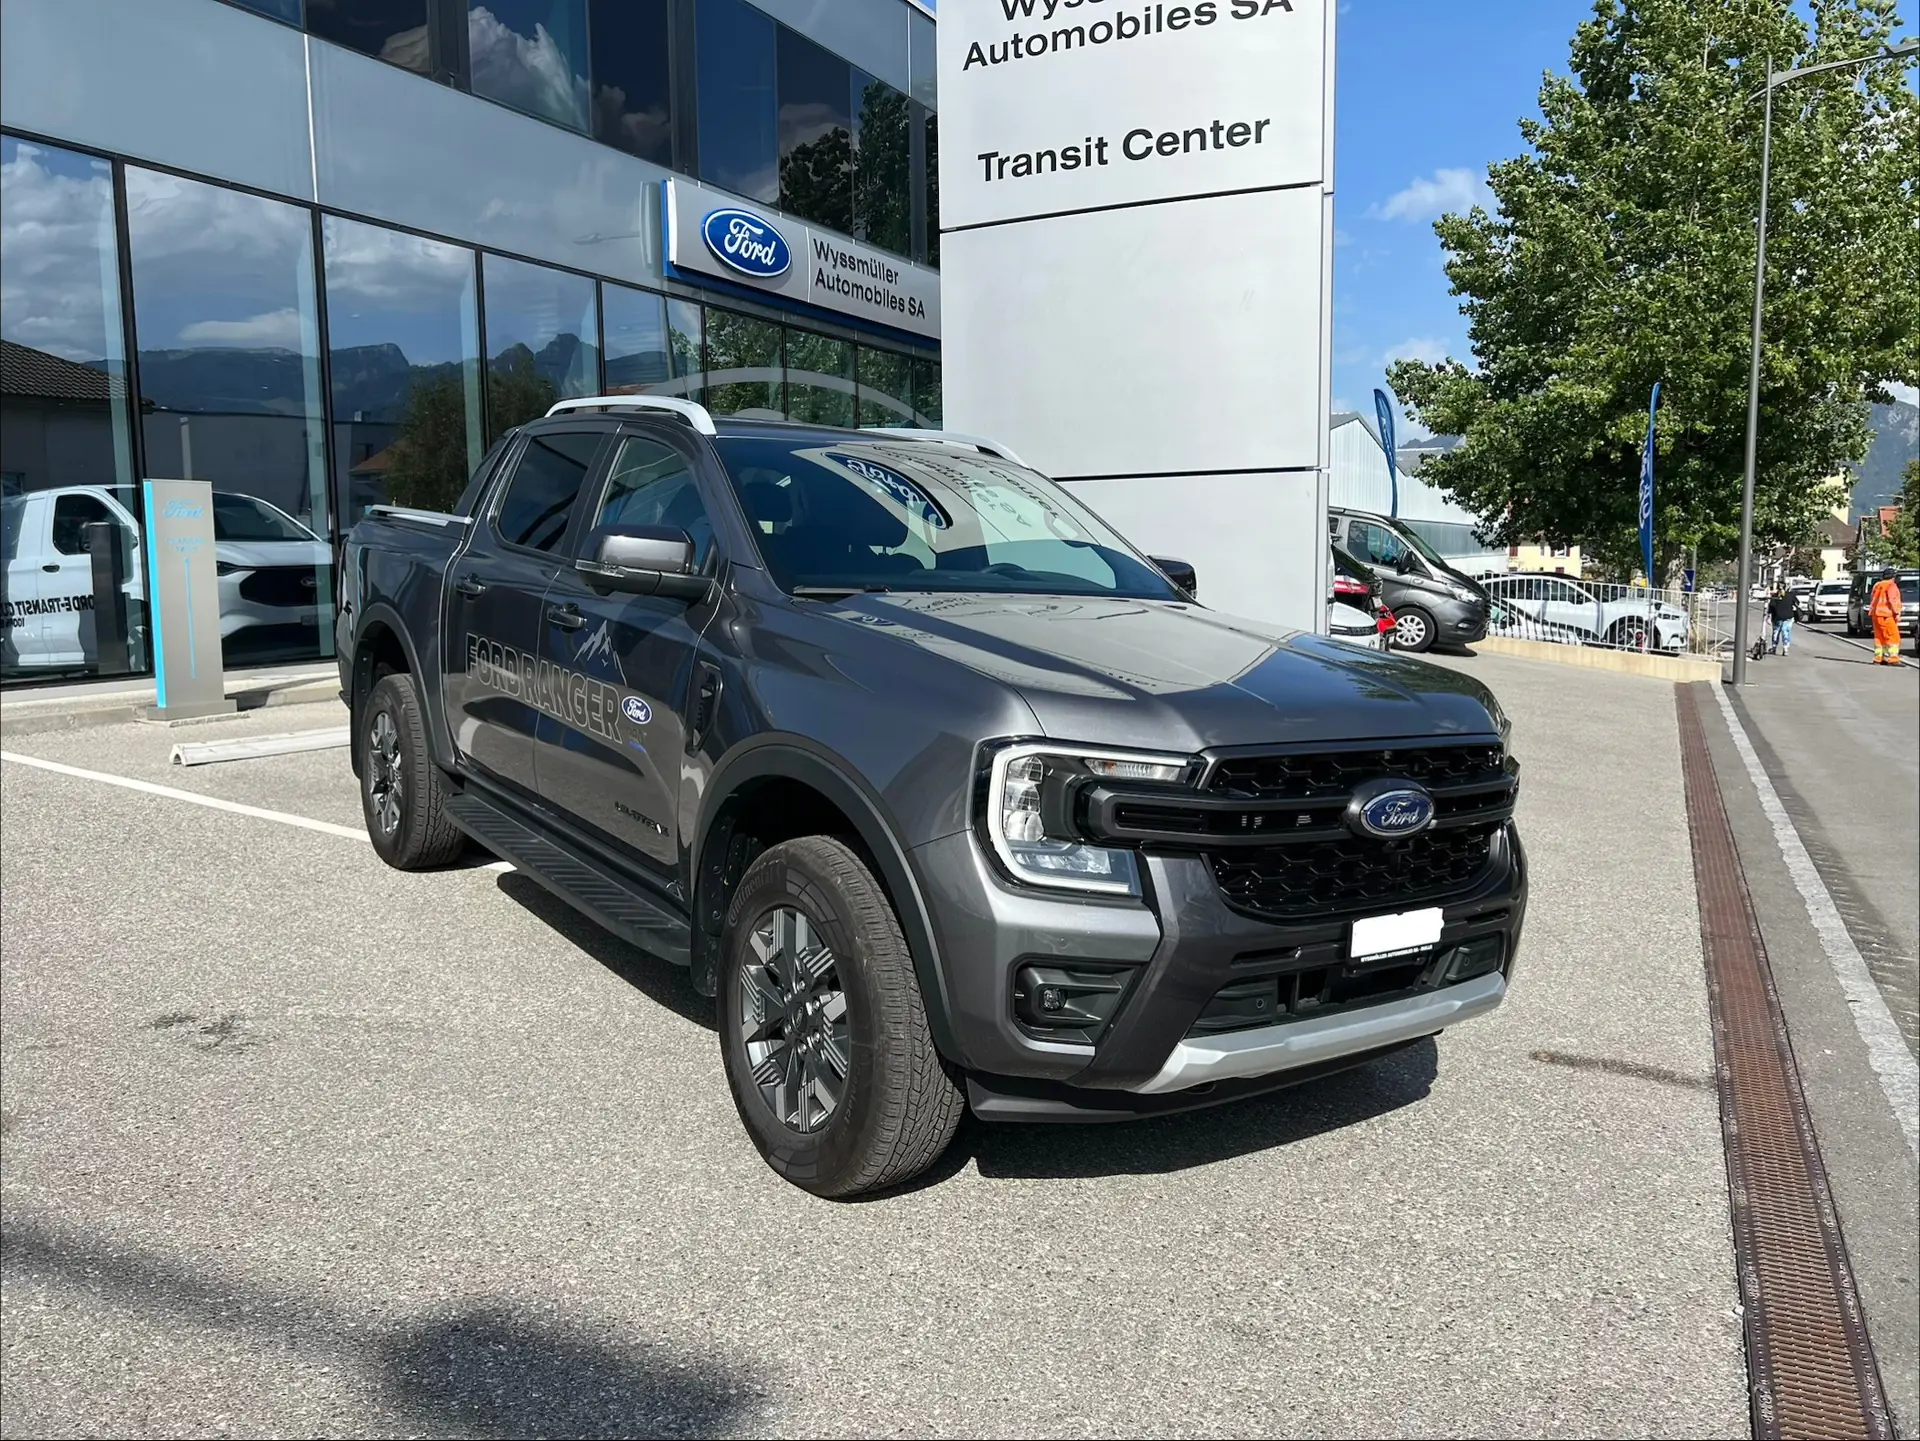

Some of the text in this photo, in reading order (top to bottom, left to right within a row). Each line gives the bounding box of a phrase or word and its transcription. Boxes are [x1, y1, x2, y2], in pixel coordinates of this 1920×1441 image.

[963, 3, 1217, 71] Automobiles
[978, 118, 1271, 181] Transit Center
[724, 218, 777, 266] Ford
[813, 238, 899, 285] Wyssmüller
[815, 268, 925, 319] Automobiles SA
[466, 633, 623, 744] FORD RANGER
[627, 698, 649, 720] Ford
[1381, 801, 1420, 827] Ford
